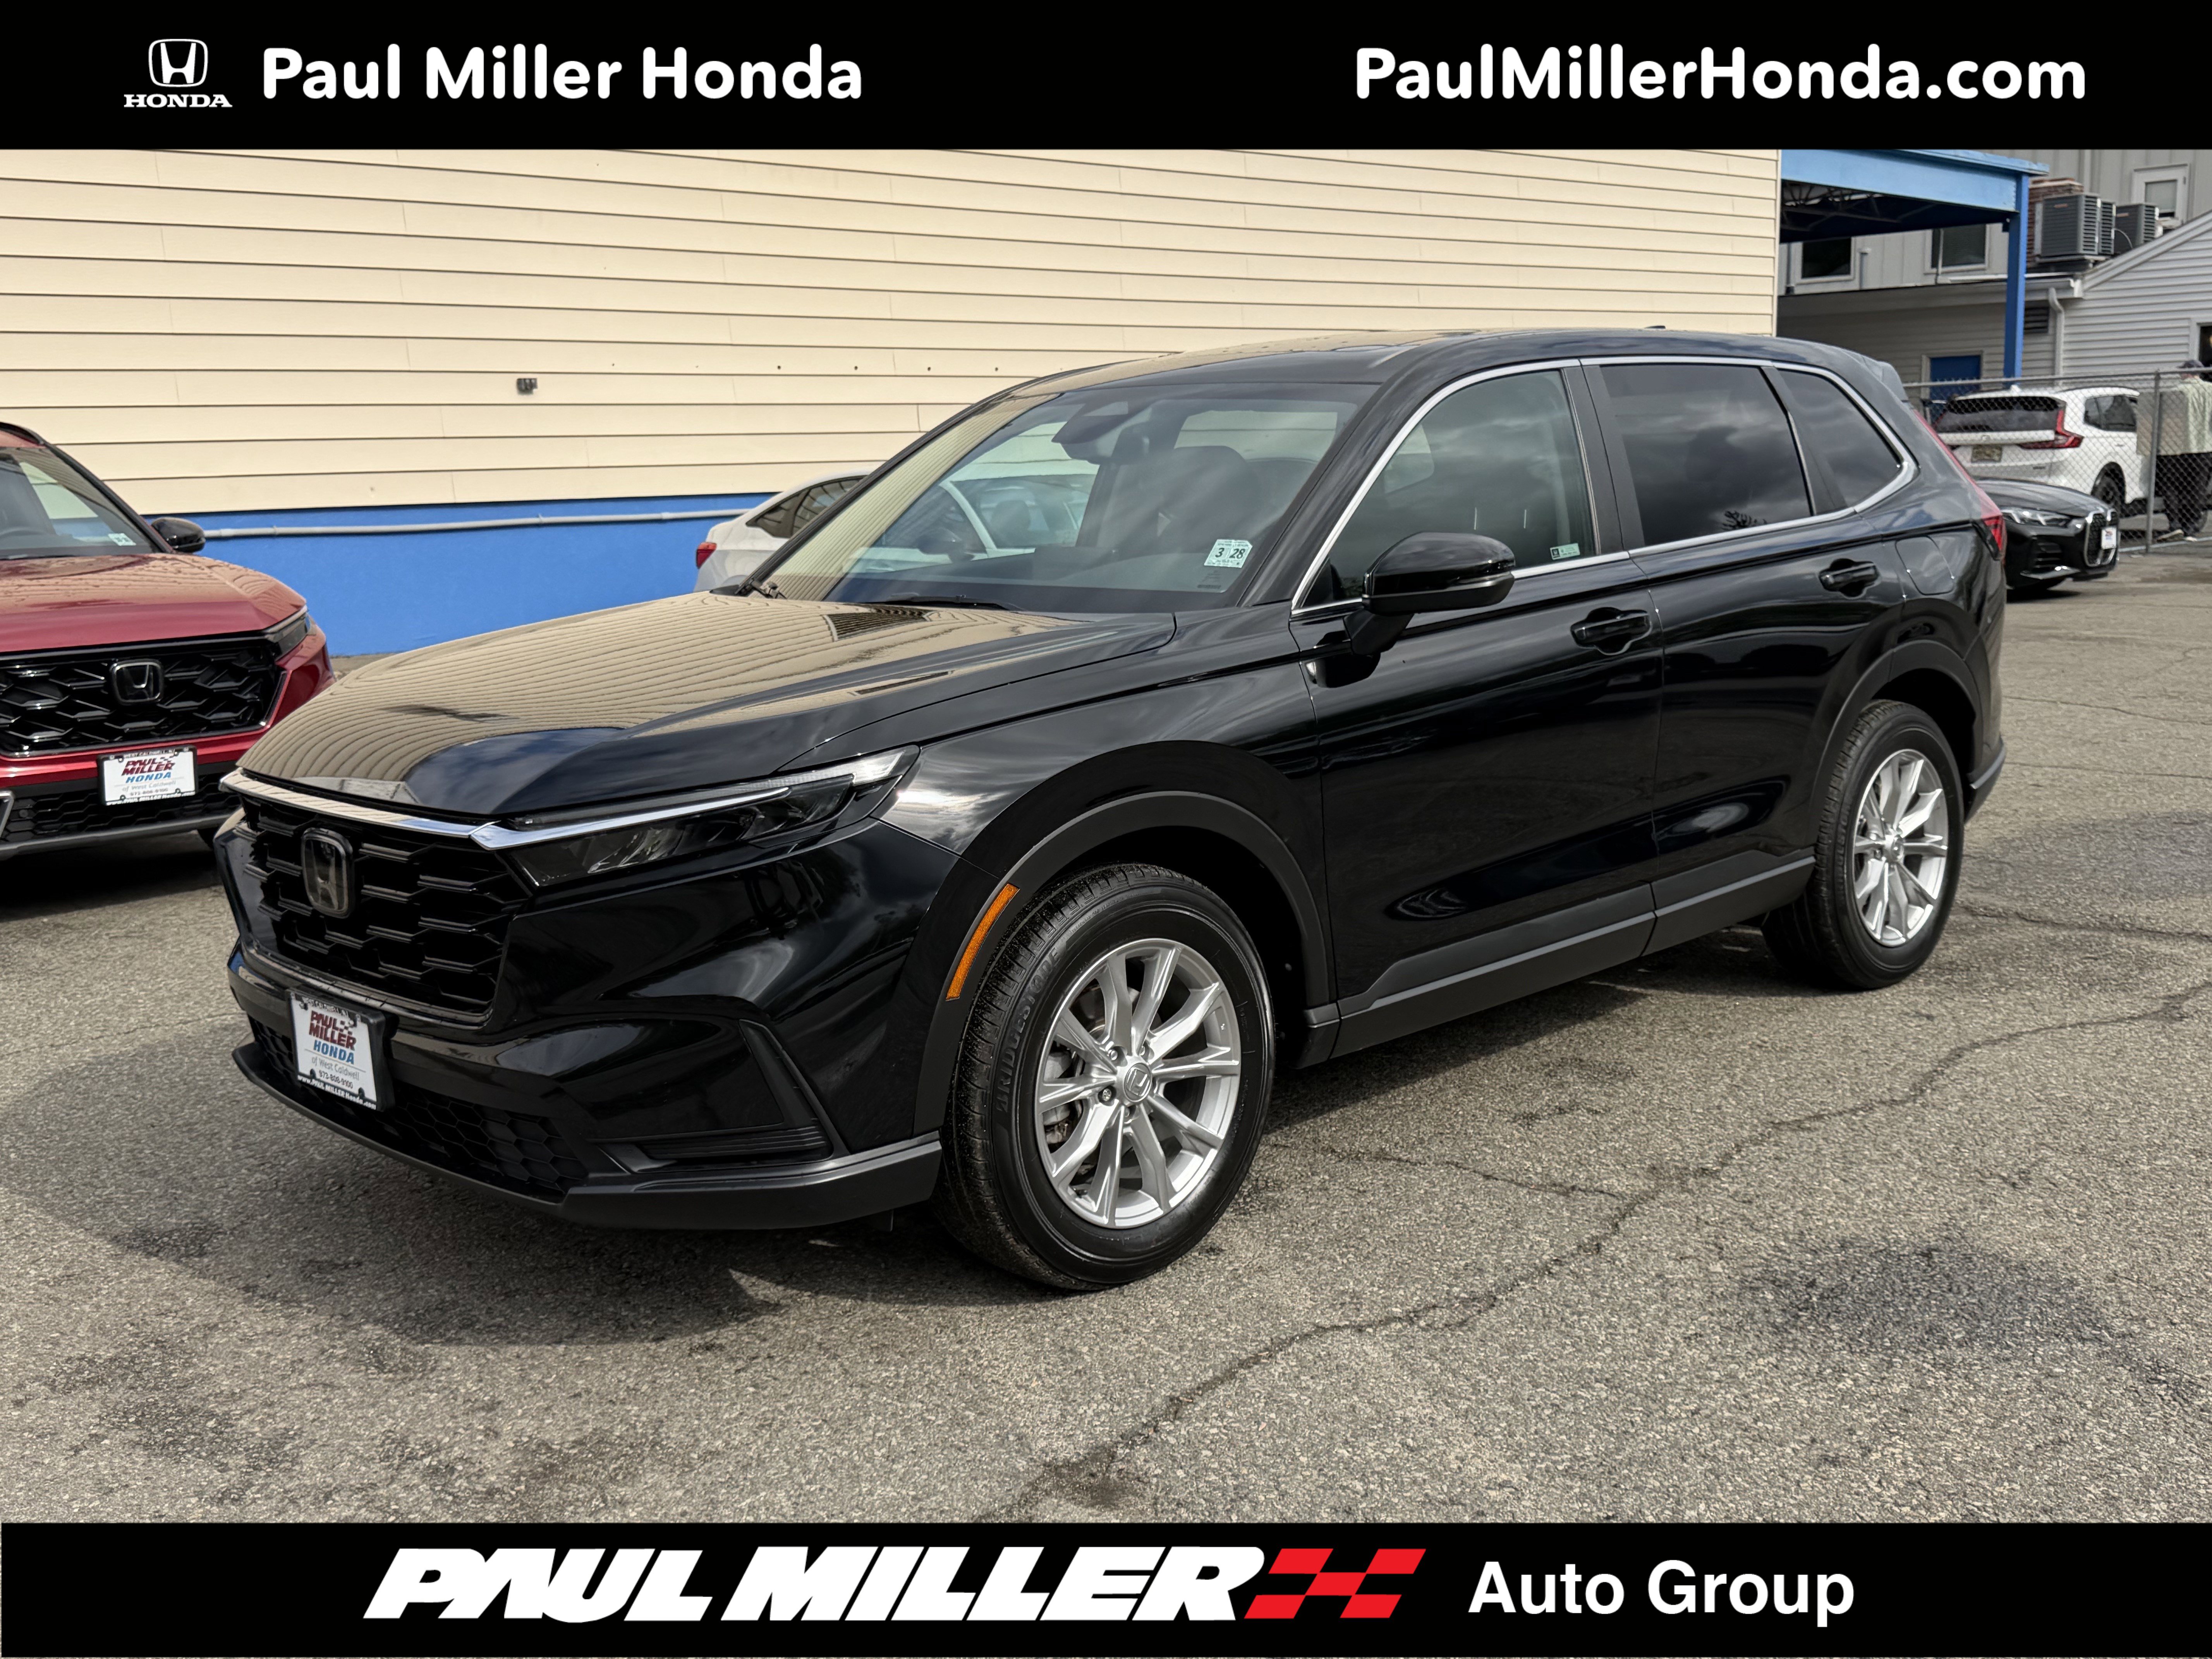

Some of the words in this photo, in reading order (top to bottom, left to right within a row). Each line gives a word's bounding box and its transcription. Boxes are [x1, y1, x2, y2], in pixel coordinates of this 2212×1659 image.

[1215, 548, 1224, 558] 3
[1229, 548, 1245, 559] 28
[121, 762, 175, 776] MILLER
[125, 758, 159, 767] PAUL
[125, 772, 172, 783] HONDA
[311, 1010, 339, 1030] PAUL
[309, 1022, 357, 1051] MILLER
[314, 1039, 354, 1065] HONDA
[311, 1056, 318, 1066] of
[319, 1058, 333, 1072] West
[335, 1065, 360, 1081] Caldwell
